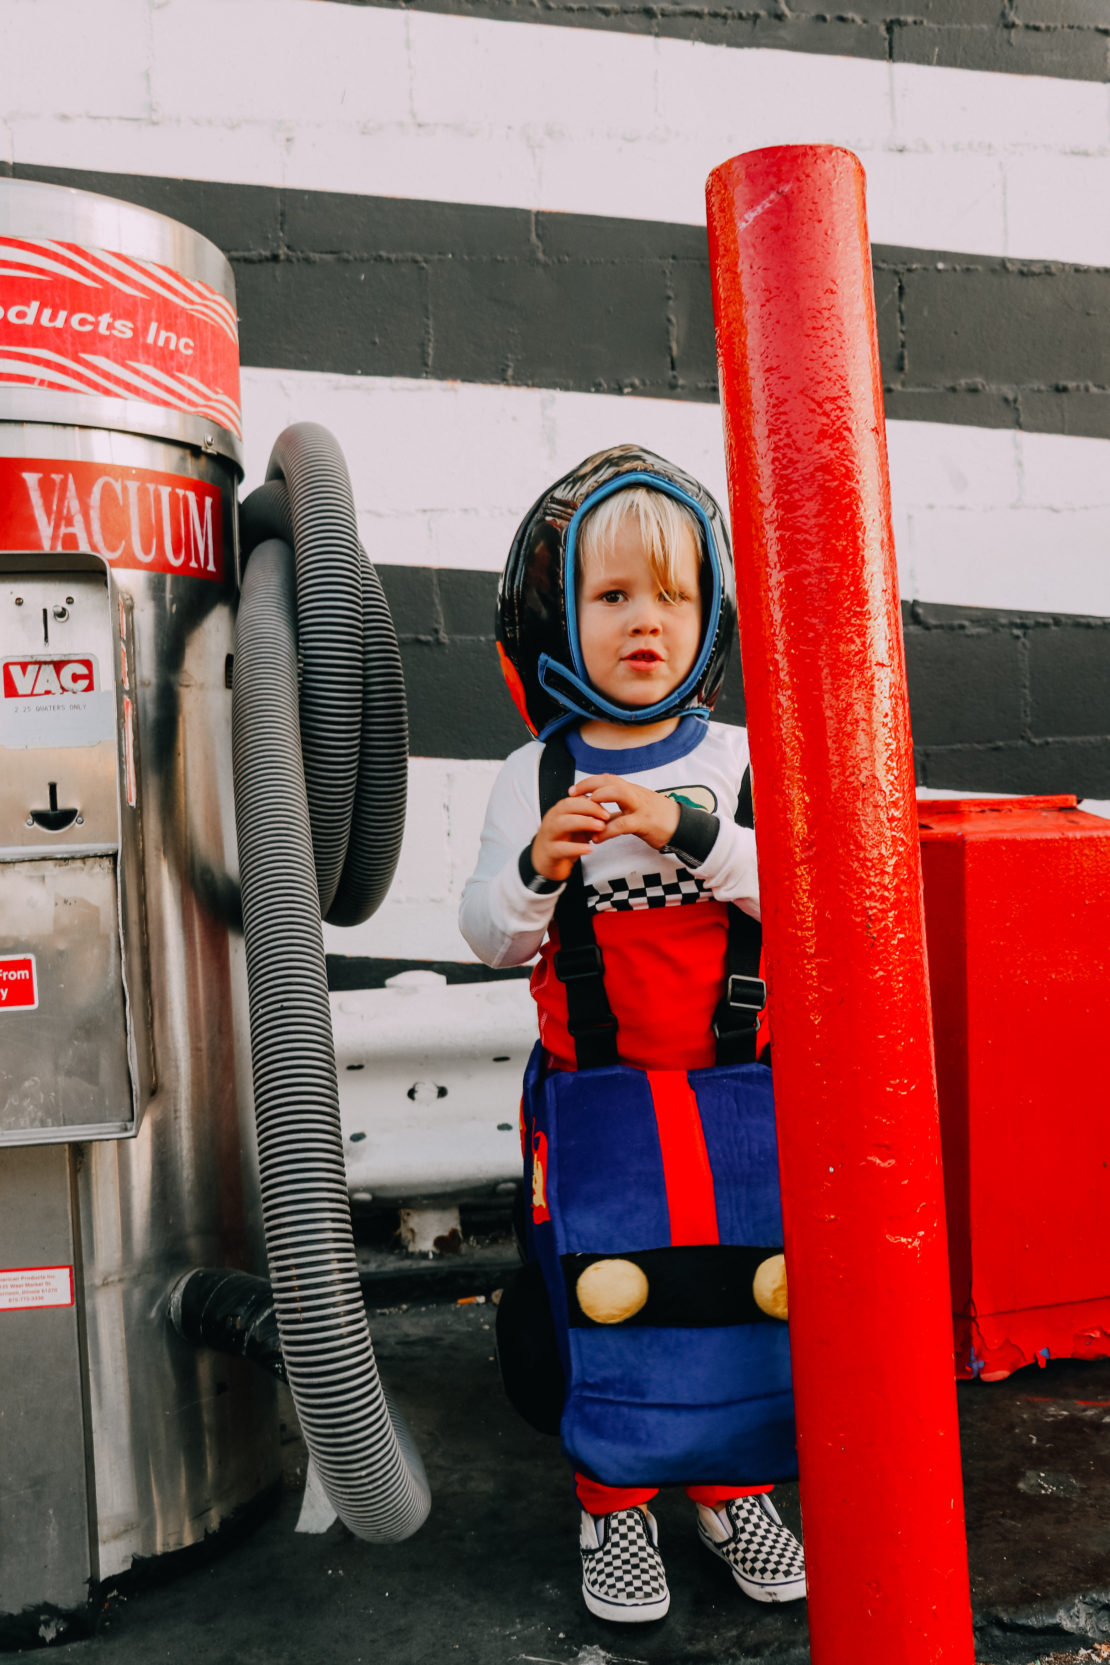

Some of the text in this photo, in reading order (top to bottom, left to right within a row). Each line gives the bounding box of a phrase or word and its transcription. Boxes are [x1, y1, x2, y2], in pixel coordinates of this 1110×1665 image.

[0, 301, 195, 355] ducts Inc
[22, 472, 217, 573] VACUUM
[8, 662, 90, 695] VAC
[69, 703, 87, 711] ONLY
